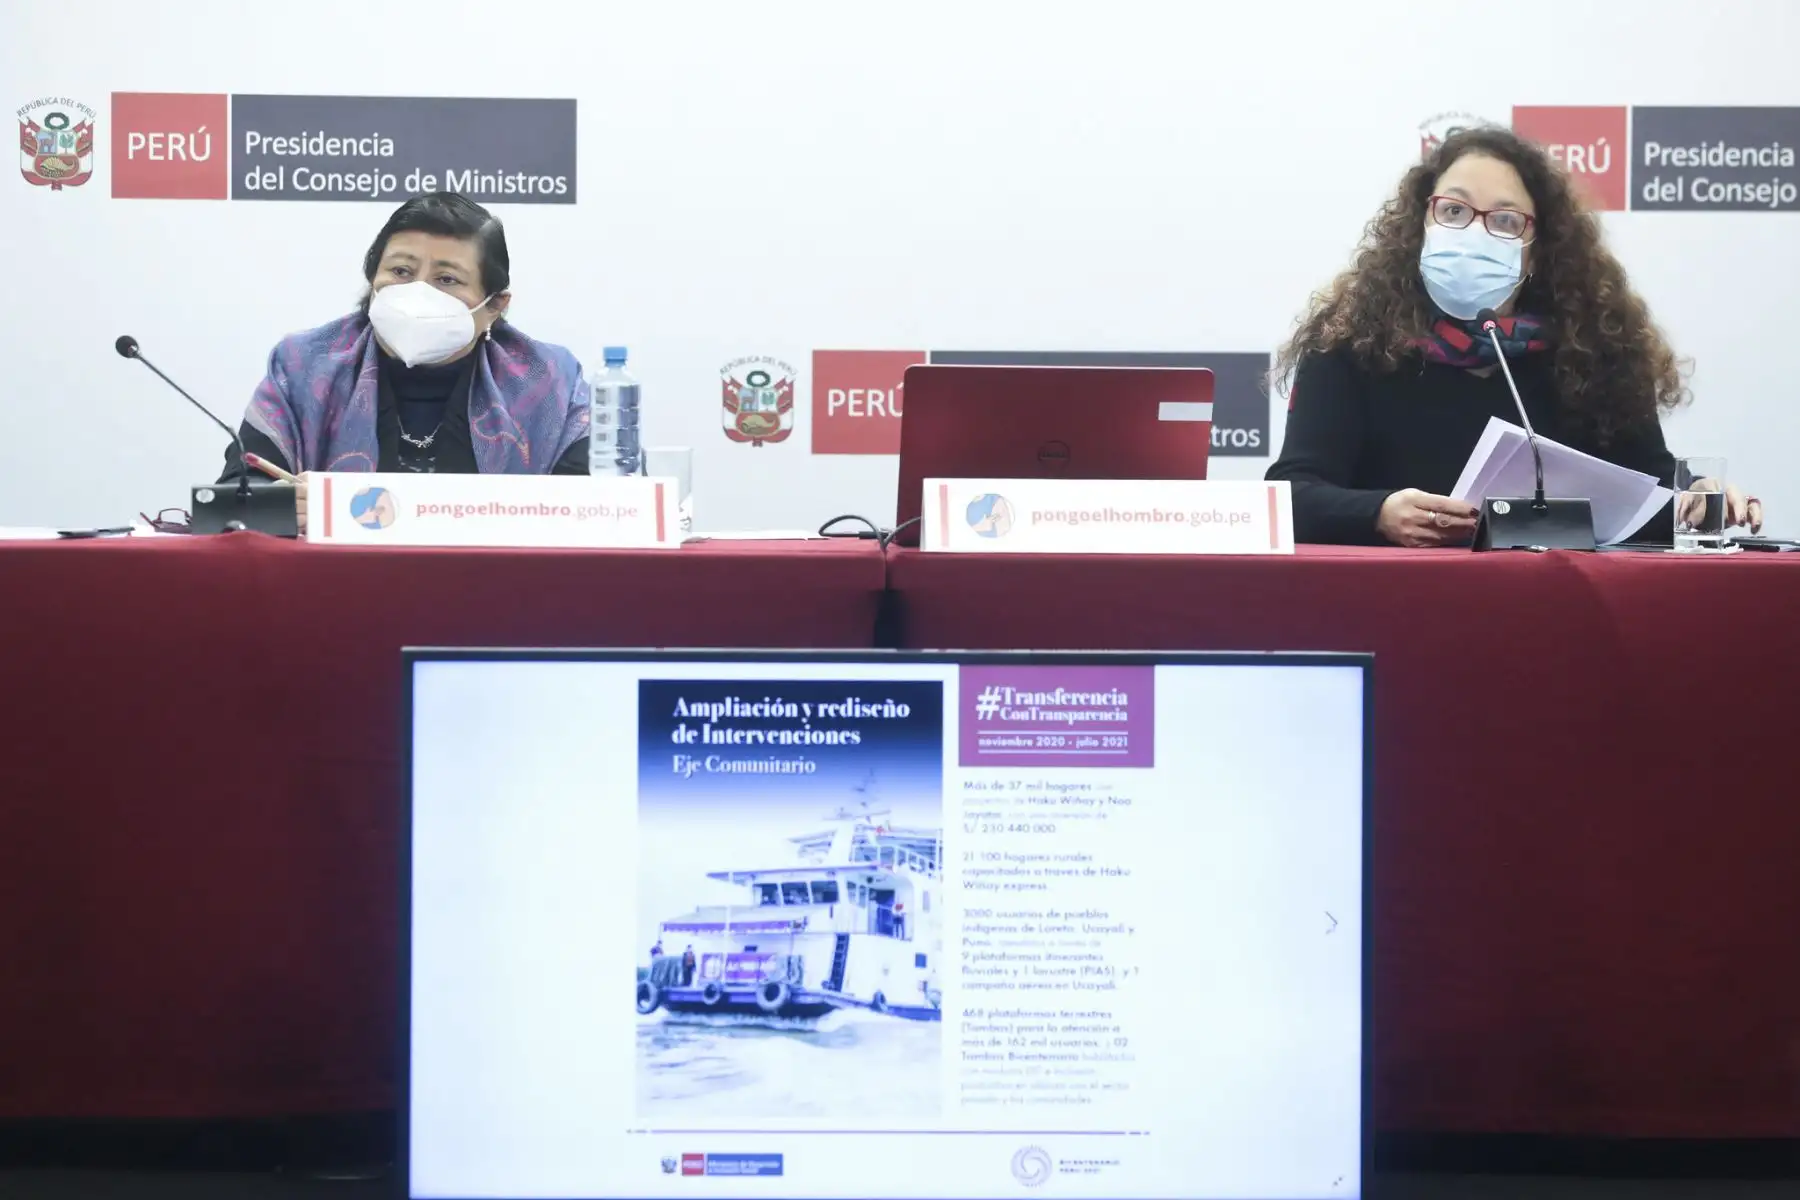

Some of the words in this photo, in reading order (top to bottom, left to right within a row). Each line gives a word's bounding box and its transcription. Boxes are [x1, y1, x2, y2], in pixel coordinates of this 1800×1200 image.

[60, 97, 74, 108] DEL
[127, 126, 213, 162] PERÚ
[245, 131, 394, 157] Presidencia
[1644, 141, 1795, 167] Presidencia
[244, 167, 288, 191] del
[291, 169, 397, 197] Consejo
[405, 168, 438, 193] de
[445, 169, 568, 195] Ministros
[1643, 177, 1683, 202] del
[1690, 177, 1798, 208] Consejo
[416, 501, 638, 522] pongoelhombro.gob.pe
[1031, 508, 1251, 527] pongoelhombro.gob.pe
[673, 696, 798, 723] Ampliación
[801, 702, 815, 723] y
[818, 697, 910, 718] rediseño
[976, 686, 1128, 721] #Transferencia
[1000, 706, 1128, 725] ConTransparencia
[671, 723, 698, 744] de
[702, 724, 861, 745] Intervenciones
[979, 736, 1033, 747] noviembre
[1036, 736, 1065, 747] 2020
[1076, 737, 1099, 749] julio
[1102, 737, 1128, 748] 2021
[672, 755, 701, 778] Eje
[705, 755, 816, 773] Comunitario
[991, 780, 1004, 790] de
[1008, 781, 1022, 790] 37
[1045, 781, 1092, 793] hogares
[1007, 823, 1030, 833] 440
[1033, 823, 1056, 833] 000
[1004, 851, 1051, 864] hogares
[1053, 851, 1093, 861] rurales
[1082, 866, 1096, 876] de
[1046, 908, 1061, 919] de
[1021, 923, 1035, 933] de
[972, 951, 1041, 964] plataformas
[987, 1008, 1056, 1020] plataformas
[987, 1036, 1002, 1046] de
